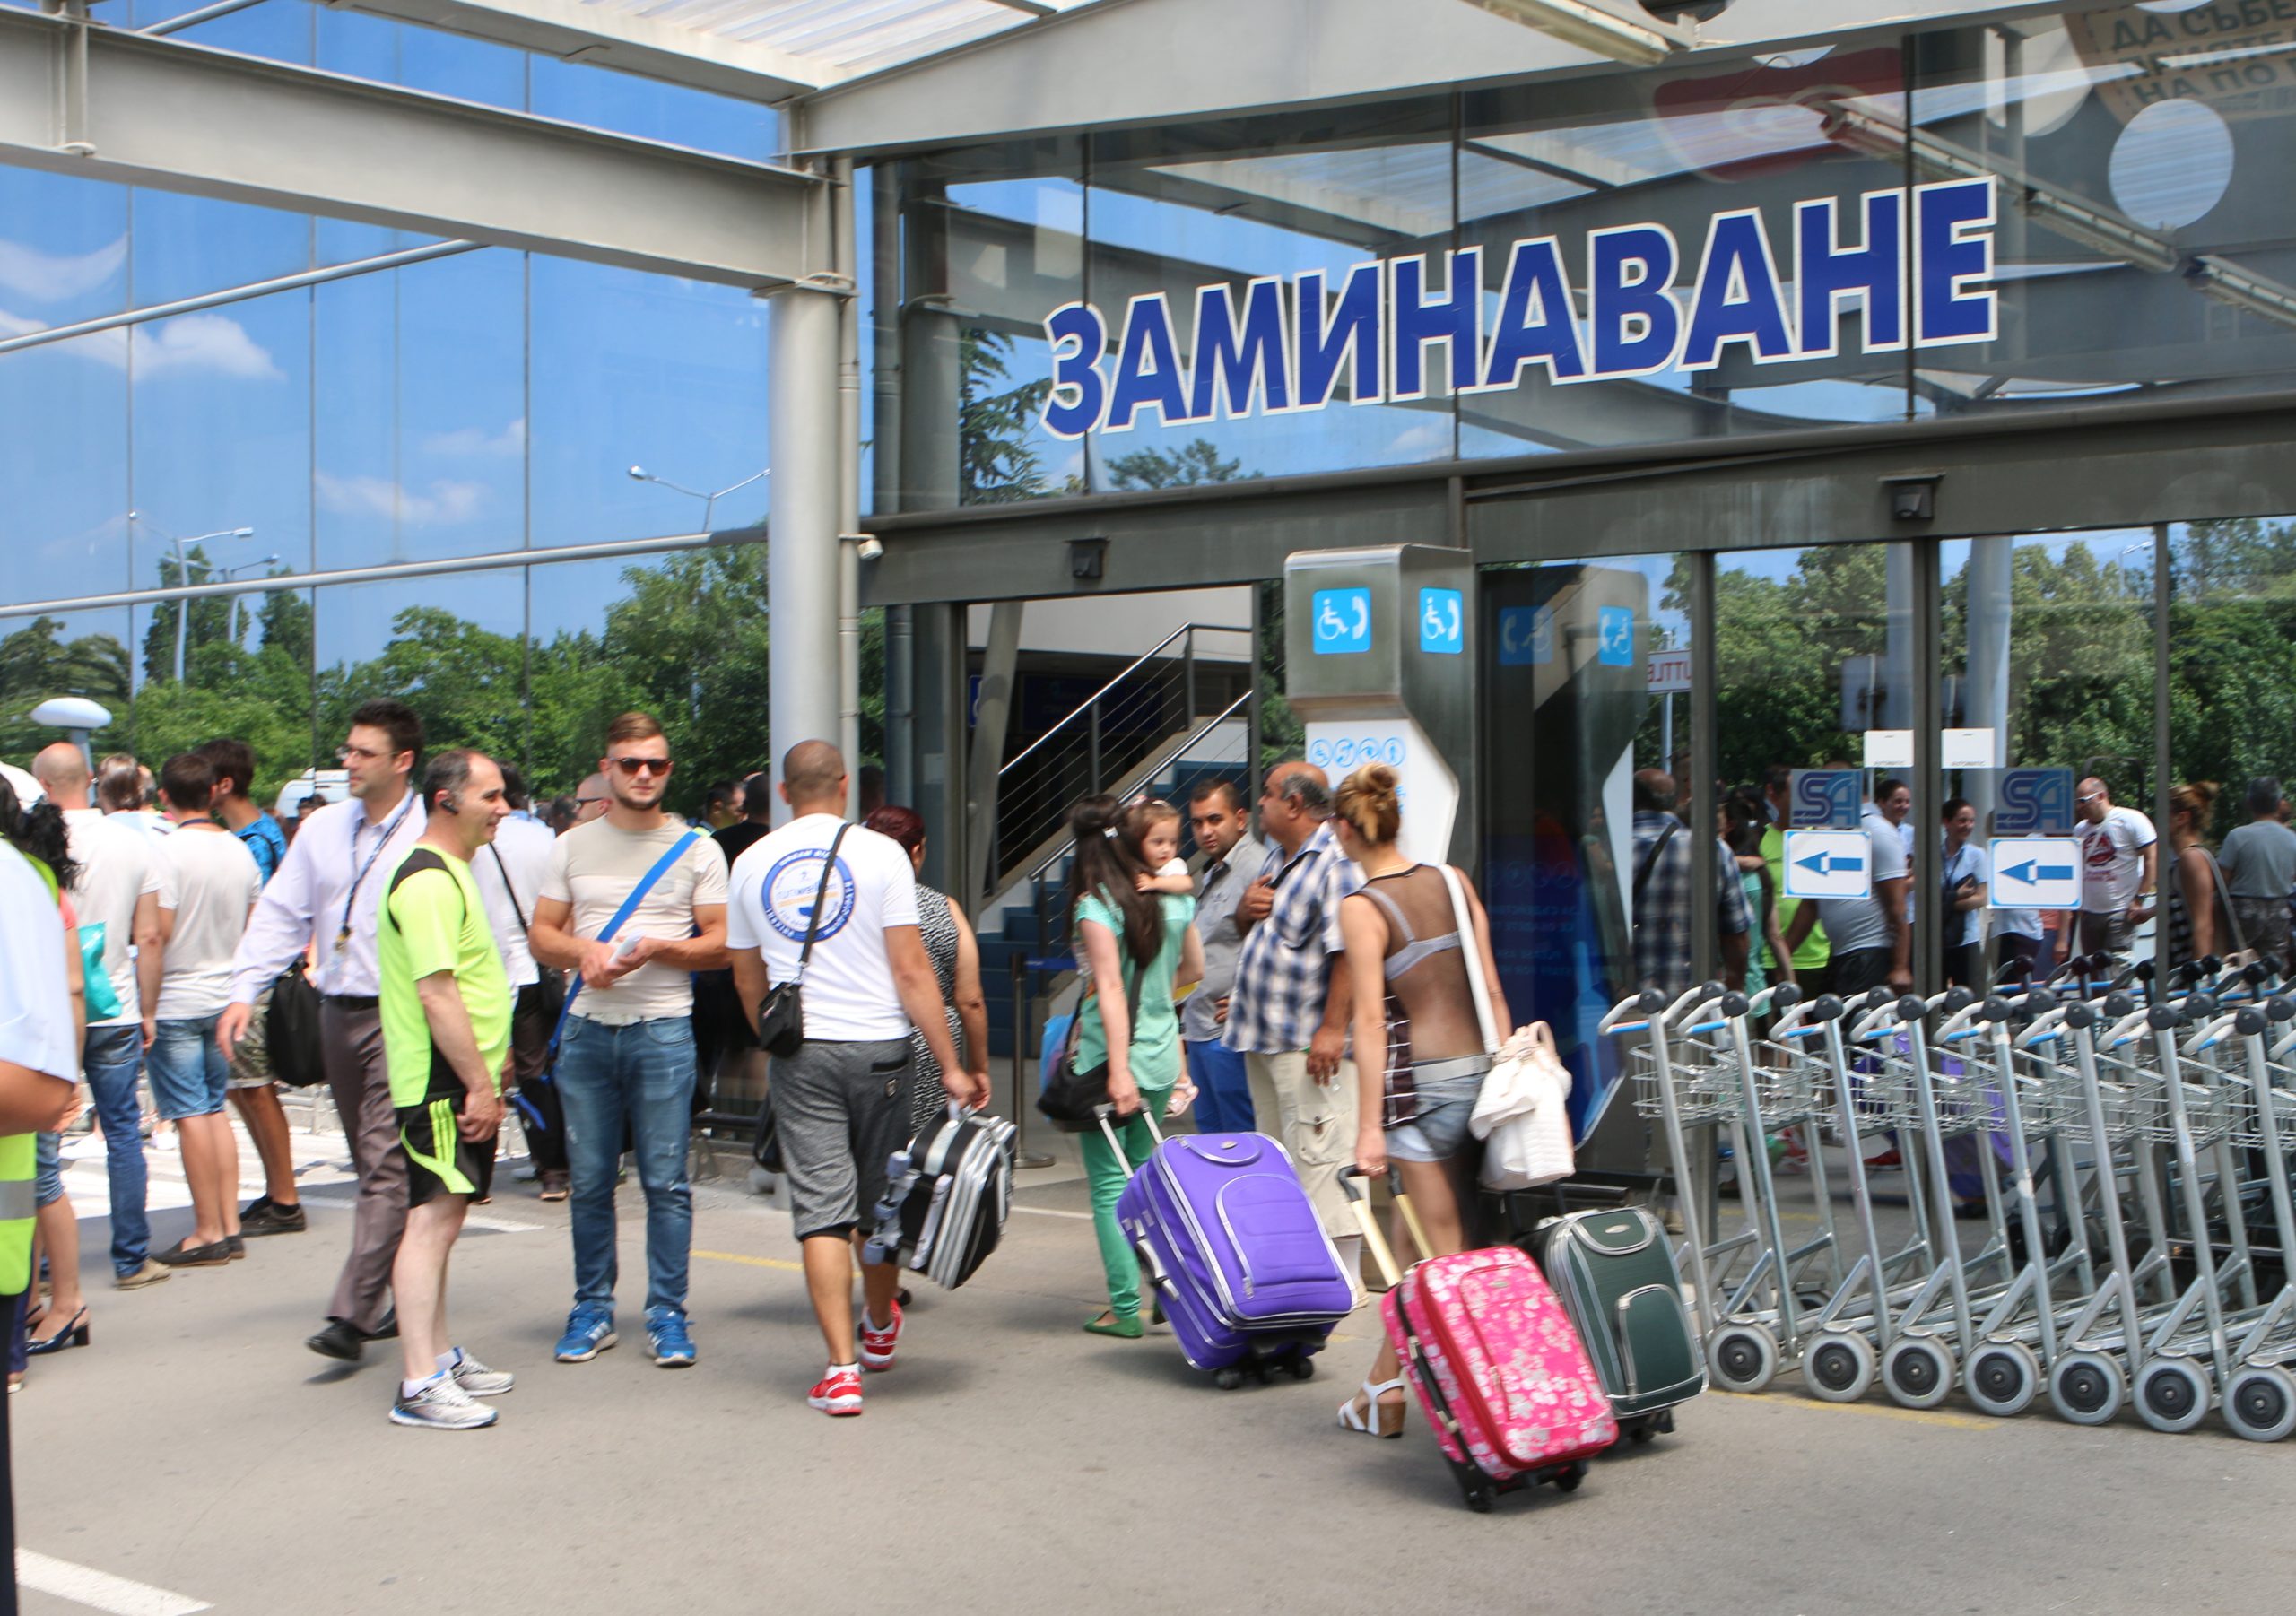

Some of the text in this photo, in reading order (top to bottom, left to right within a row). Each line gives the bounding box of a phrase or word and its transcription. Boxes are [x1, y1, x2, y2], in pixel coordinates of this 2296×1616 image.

[2110, 14, 2175, 52] ДА
[2131, 77, 2204, 105] НА
[1040, 175, 1997, 439] ЗАМИНАВАНЕ
